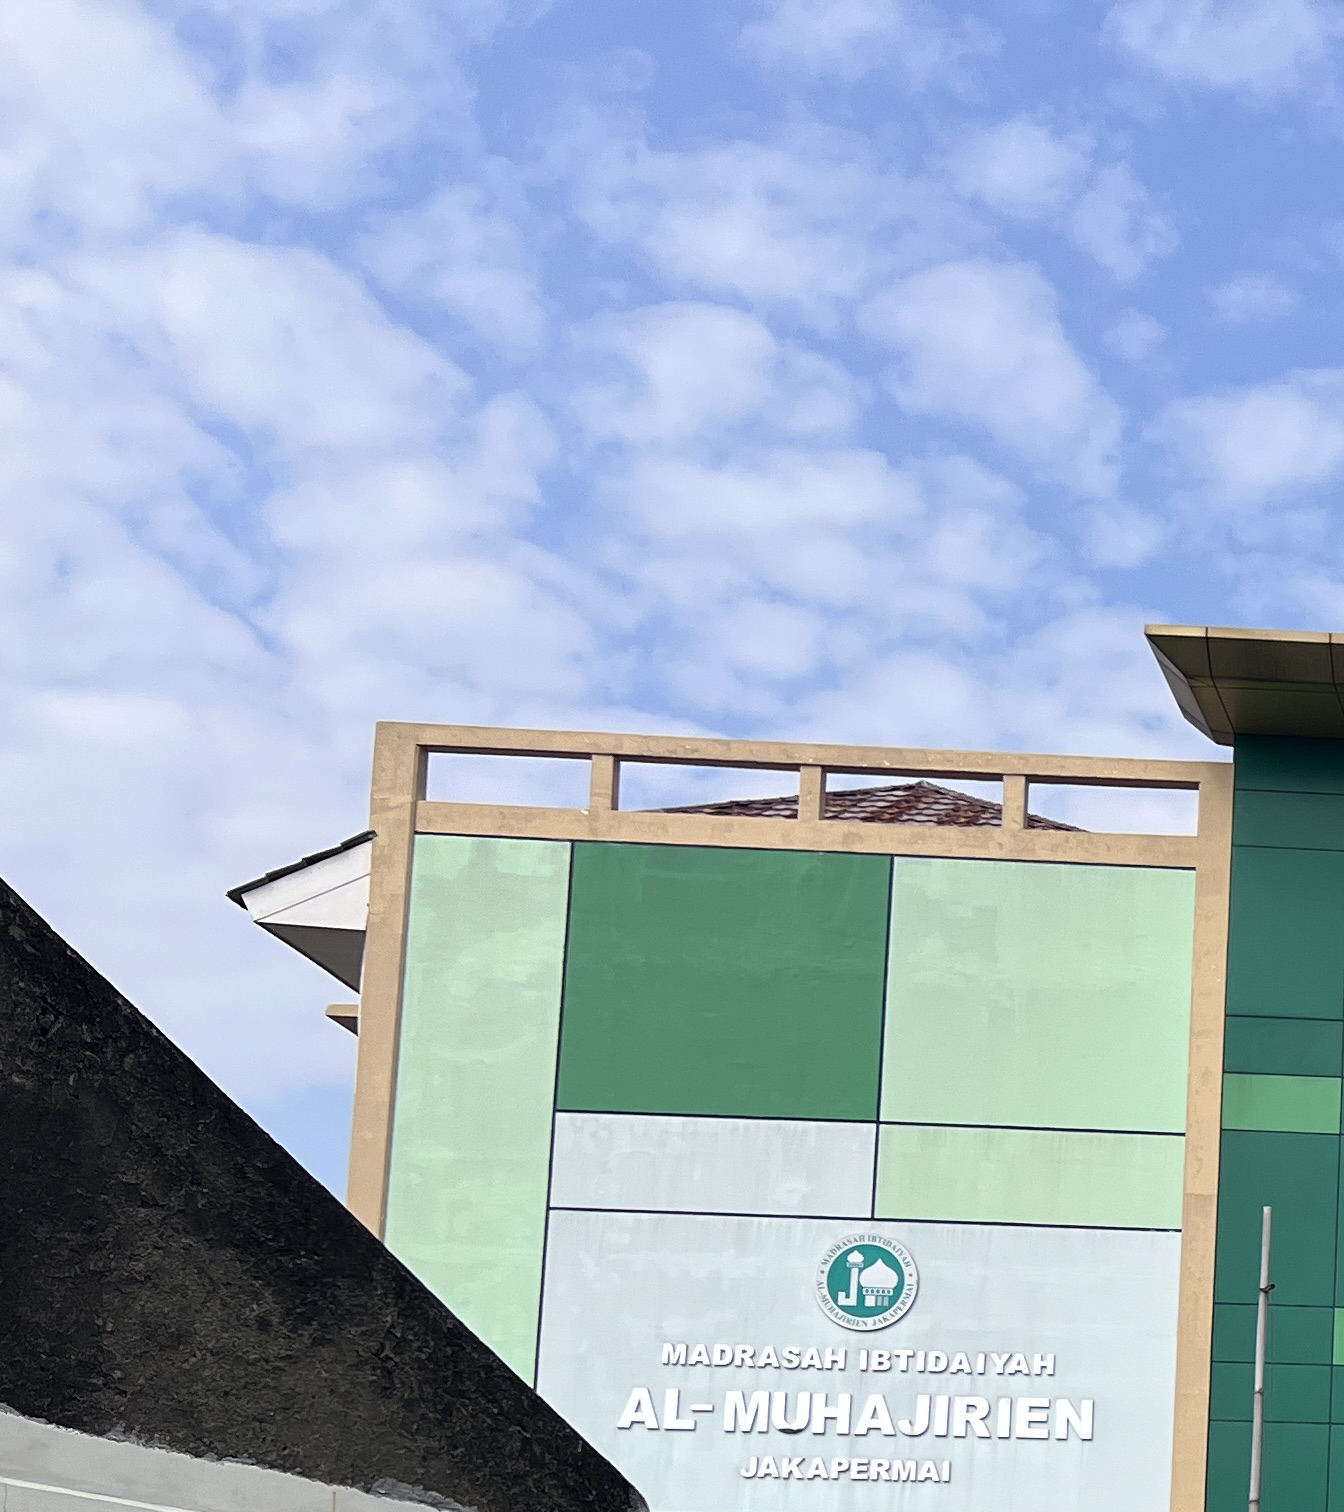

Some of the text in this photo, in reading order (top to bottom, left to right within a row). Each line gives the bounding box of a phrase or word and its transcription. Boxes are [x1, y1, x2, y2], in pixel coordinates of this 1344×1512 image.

[821, 1234, 913, 1268] MADRASAH IBTIDAIYAH
[661, 1342, 1056, 1376] MADRASAH IBTIDAIYAH
[740, 1455, 951, 1483] JAKAPERMAI
